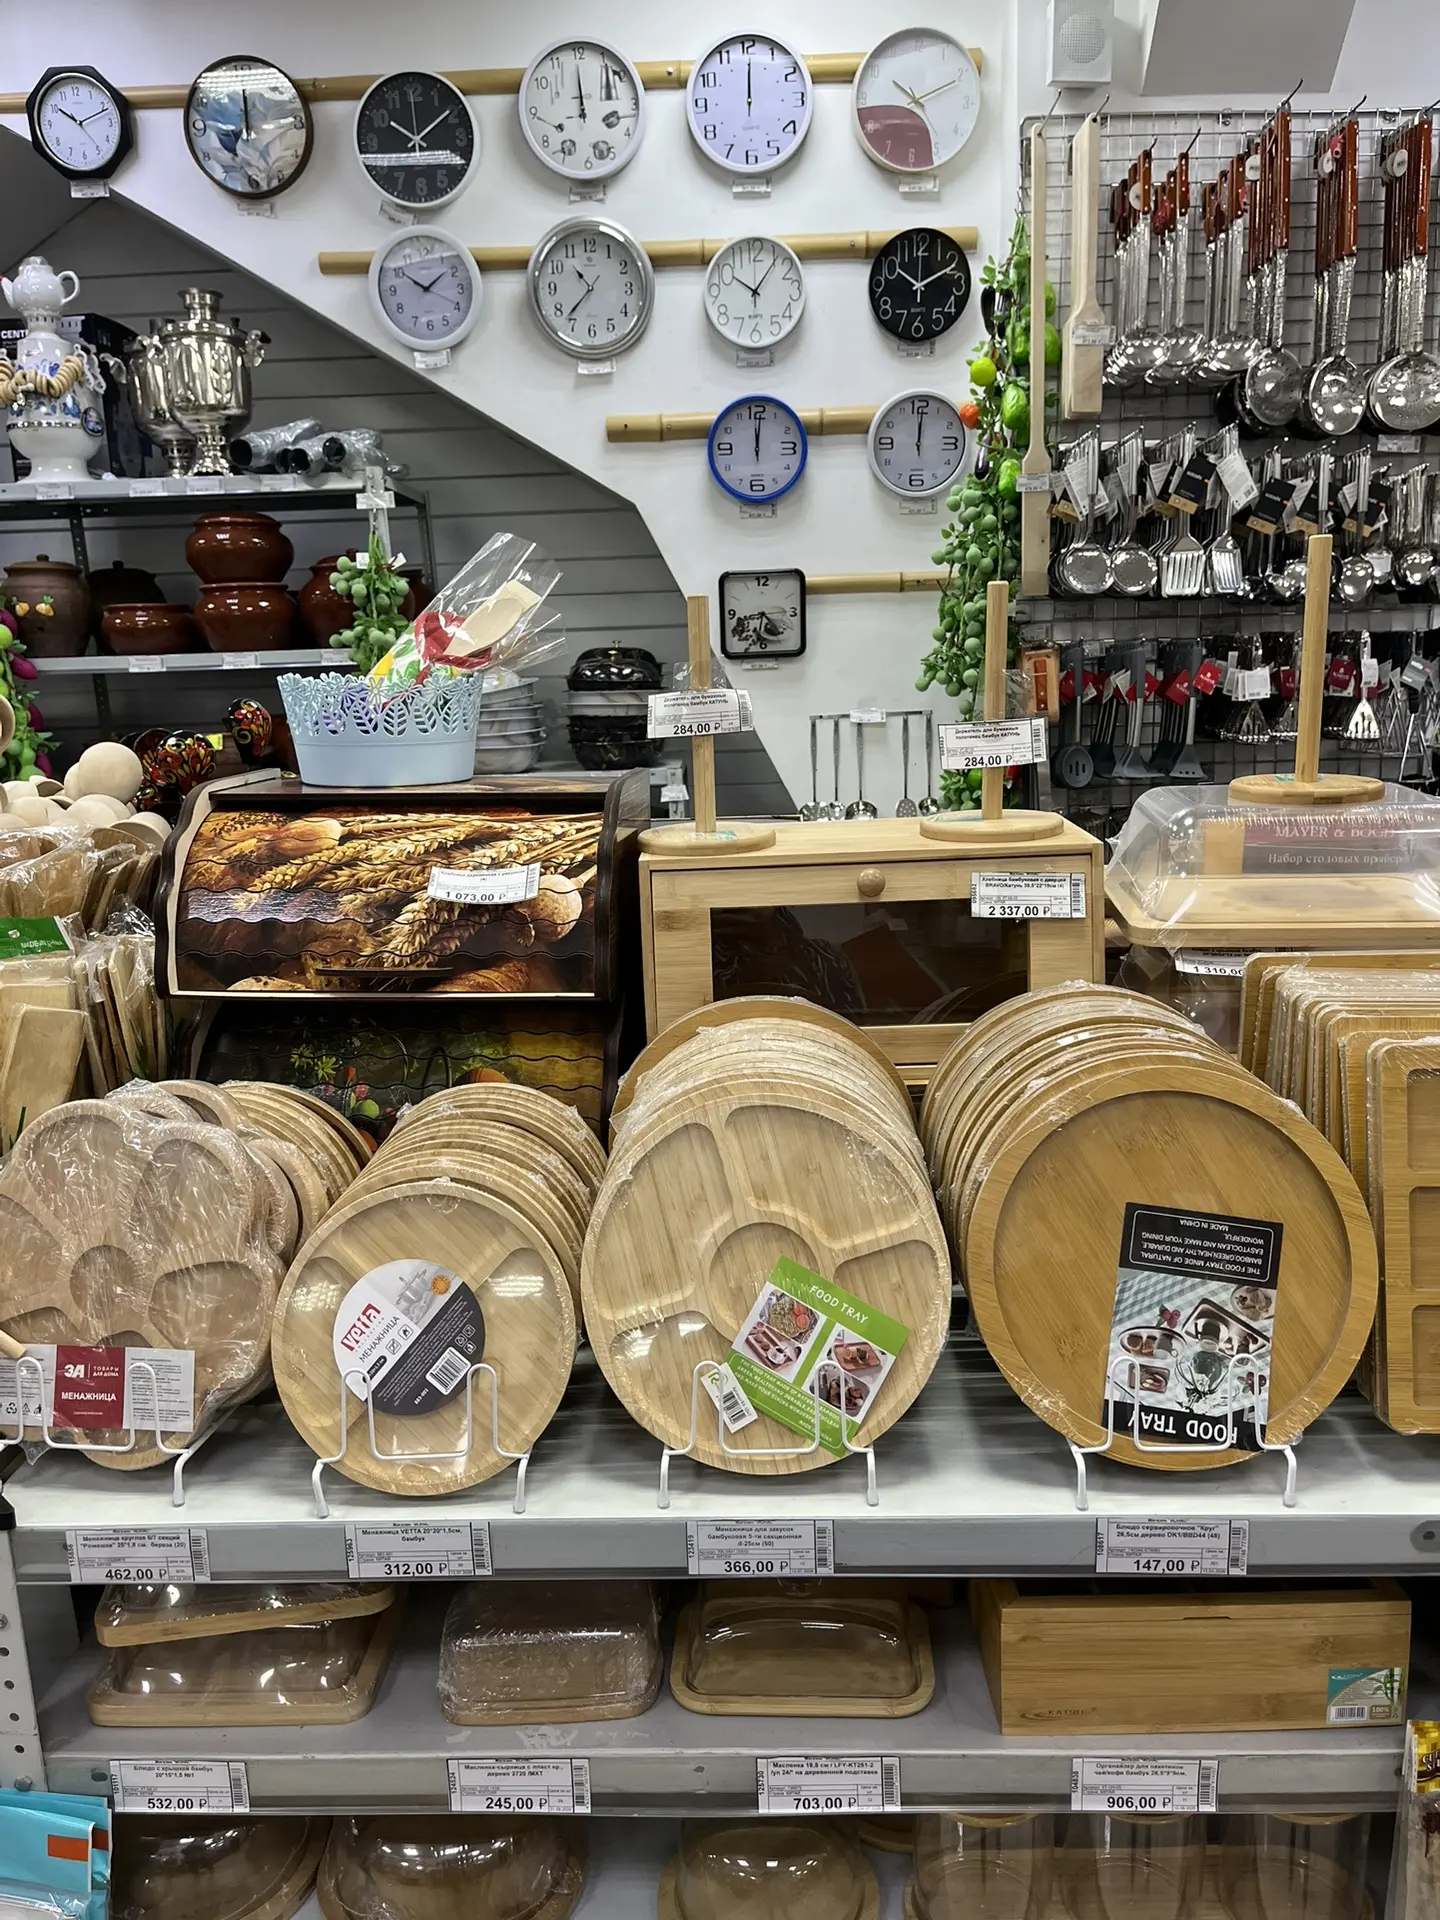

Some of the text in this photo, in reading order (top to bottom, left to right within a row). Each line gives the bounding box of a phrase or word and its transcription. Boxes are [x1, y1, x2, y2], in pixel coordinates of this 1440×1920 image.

[741, 40, 756, 55] 12
[770, 47, 775, 61] 1
[719, 50, 730, 64] 11
[701, 72, 716, 88] 10
[785, 66, 796, 82] 2
[695, 98, 707, 114] 9
[793, 92, 804, 107] 3
[704, 124, 716, 140] 8
[783, 120, 796, 135] 4
[724, 144, 734, 159] 7
[767, 140, 780, 156] 5
[746, 150, 758, 165] 6
[565, 244, 575, 258] 11
[583, 238, 596, 253] 12
[606, 244, 611, 258] 1
[897, 241, 908, 262] 11
[913, 233, 929, 257] 12
[937, 239, 940, 261] 1
[551, 260, 563, 274] 10
[620, 261, 628, 275] 2
[882, 256, 898, 279] 10
[946, 251, 958, 274] 2
[548, 282, 557, 296] 9
[625, 282, 633, 295] 3
[873, 276, 885, 298] 9
[953, 273, 964, 295] 3
[554, 303, 563, 317] 8
[620, 303, 628, 317] 4
[879, 297, 891, 319] 8
[944, 295, 956, 315] 4
[569, 318, 577, 332] 7
[607, 319, 615, 332] 5
[896, 310, 907, 332] 7
[912, 315, 923, 337] 6
[932, 308, 944, 330] 5
[588, 324, 596, 338] 6
[755, 576, 769, 586] 12
[728, 609, 736, 620] 9
[790, 607, 797, 617] 3
[760, 640, 767, 649] 6
[673, 723, 710, 735] 284,00
[965, 756, 1001, 767] 284,00
[1276, 826, 1328, 838] MAYER
[1269, 854, 1302, 865] Набор
[456, 893, 495, 902] 073,00
[989, 906, 995, 916] 2
[1000, 906, 1038, 918] 337,00
[1179, 1219, 1200, 1228] CHINA
[1210, 1222, 1228, 1231] MADE
[1141, 1231, 1163, 1241] DINING
[1164, 1235, 1182, 1244] YOUR
[1183, 1237, 1201, 1246] MAKE
[1171, 1245, 1184, 1253] AND
[1202, 1240, 1216, 1248] AND
[1140, 1251, 1171, 1262] NATURAL
[1205, 1261, 1224, 1270] TRAY
[1225, 1263, 1245, 1272] FOOD
[1247, 1266, 1260, 1275] THE
[809, 1285, 869, 1324] FOOD TRAY
[359, 1315, 401, 1363] МЕНАЖНИЦА
[61, 1392, 117, 1401] МЕНАЖНИЦА
[384, 1563, 433, 1576] 312,00
[724, 1561, 774, 1574] 366,00
[1134, 1559, 1184, 1573] 147,00
[105, 1569, 153, 1581] 462,00
[148, 1798, 193, 1812] 532,00
[486, 1797, 533, 1812] 245,00
[793, 1798, 842, 1812] 703,00
[1107, 1797, 1156, 1810] 906,00
